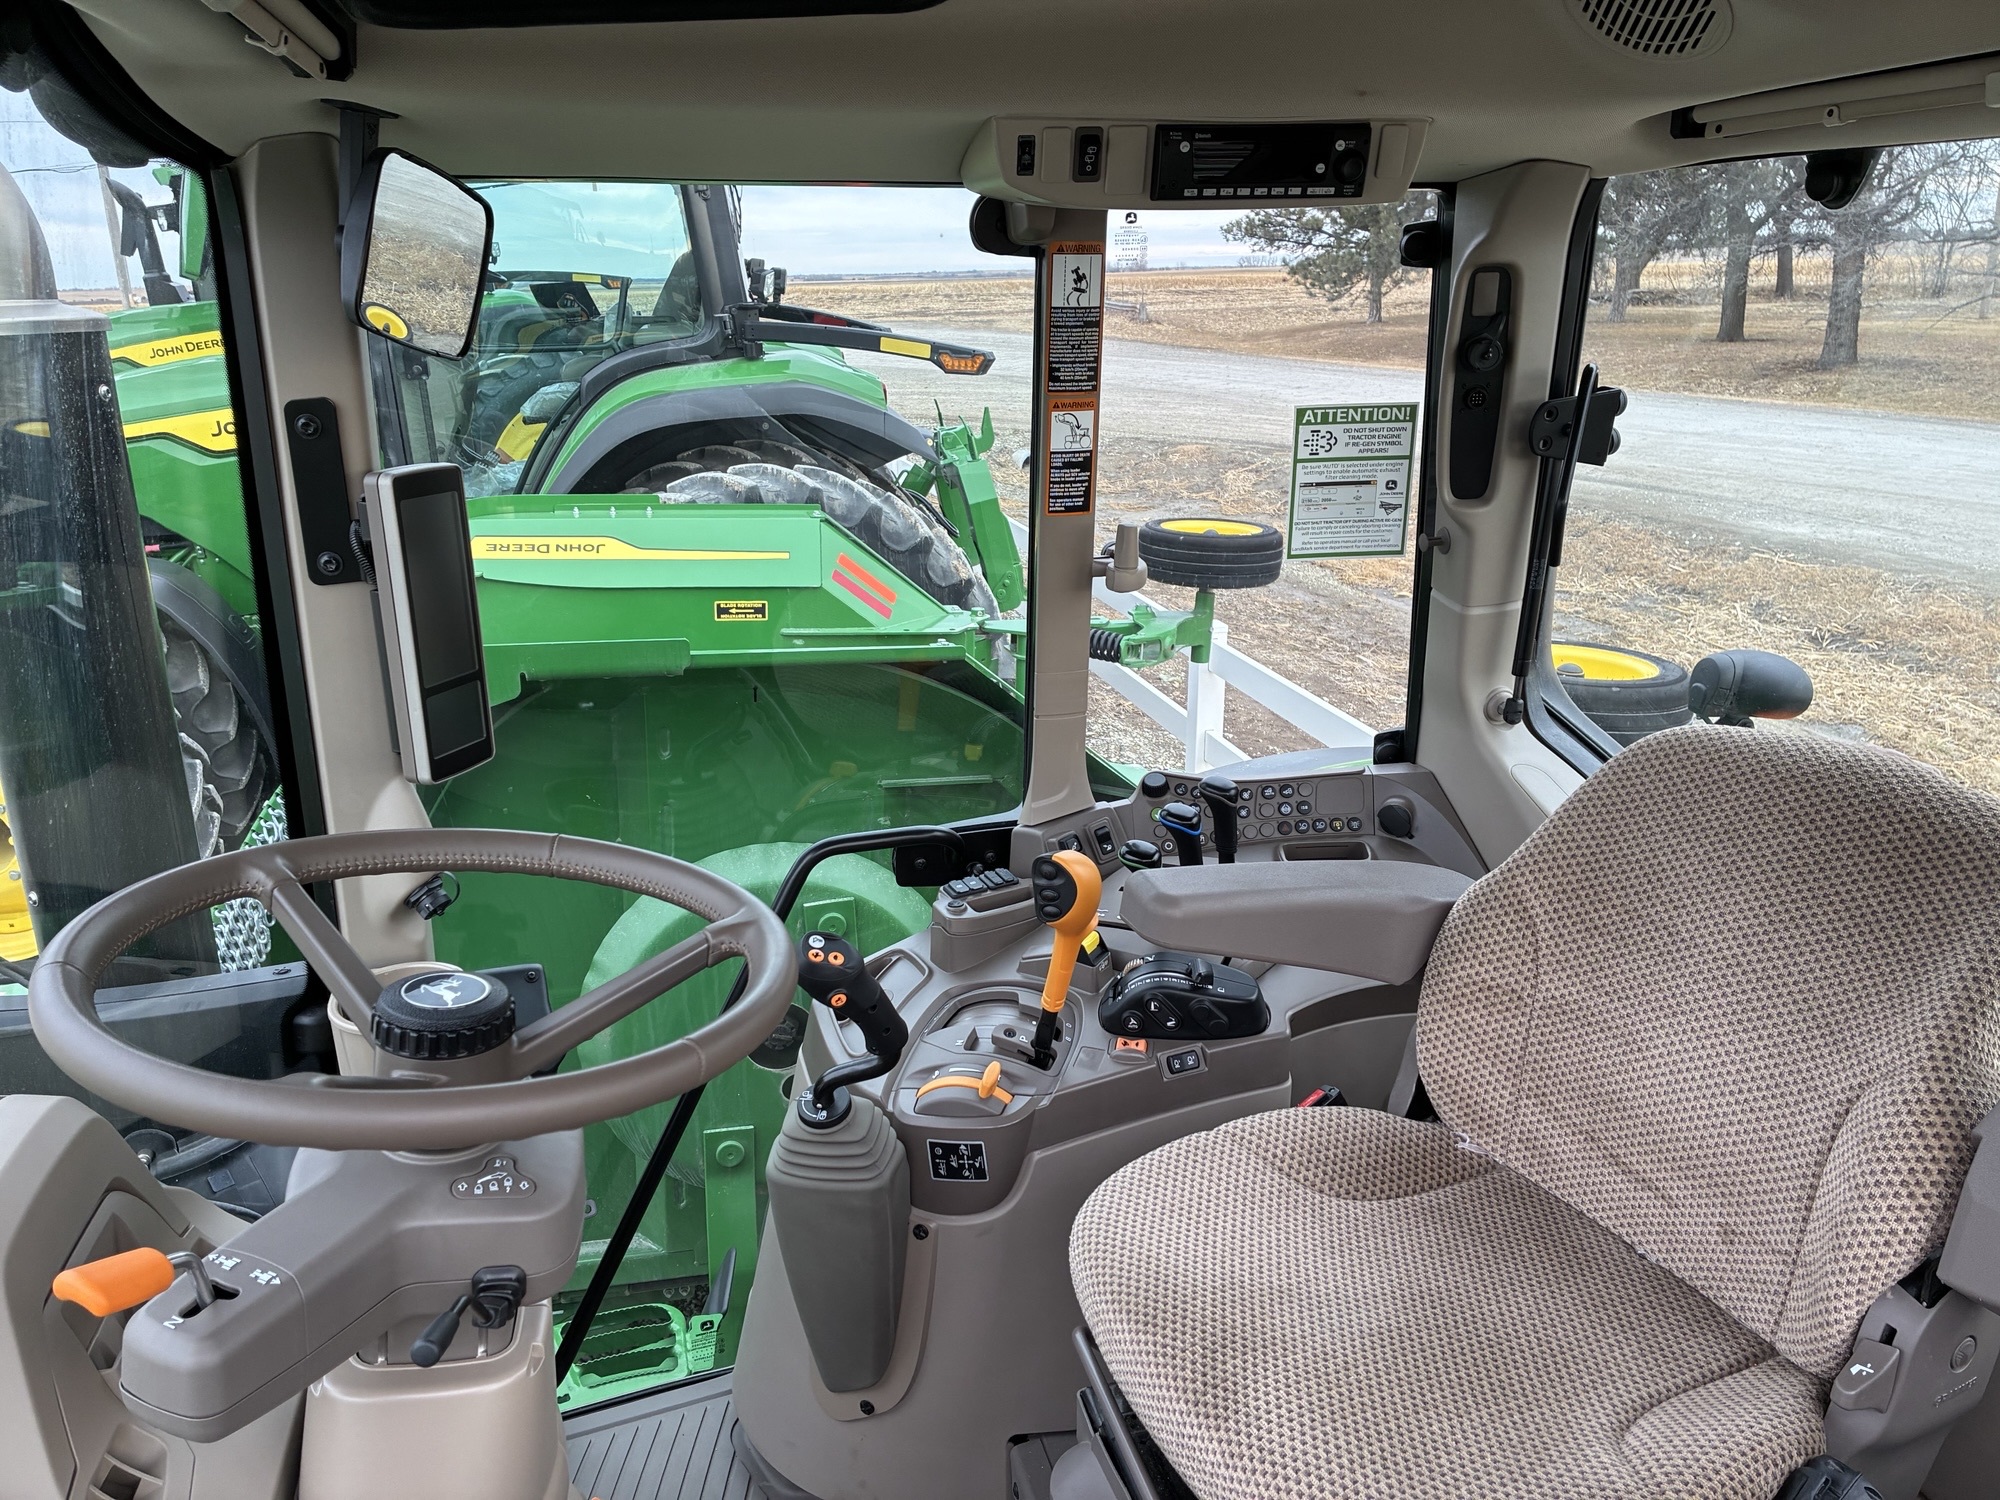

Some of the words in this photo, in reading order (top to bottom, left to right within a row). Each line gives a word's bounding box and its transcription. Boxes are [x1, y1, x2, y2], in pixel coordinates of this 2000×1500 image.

[1065, 244, 1101, 252] WARNING
[149, 344, 184, 359] JOHN
[1061, 401, 1094, 409] WARNING
[1302, 407, 1411, 423] ATTENTION!
[486, 544, 550, 553] DEERE
[555, 544, 606, 554] JOHN
[1019, 1035, 1028, 1043] P
[162, 1315, 184, 1330] N
